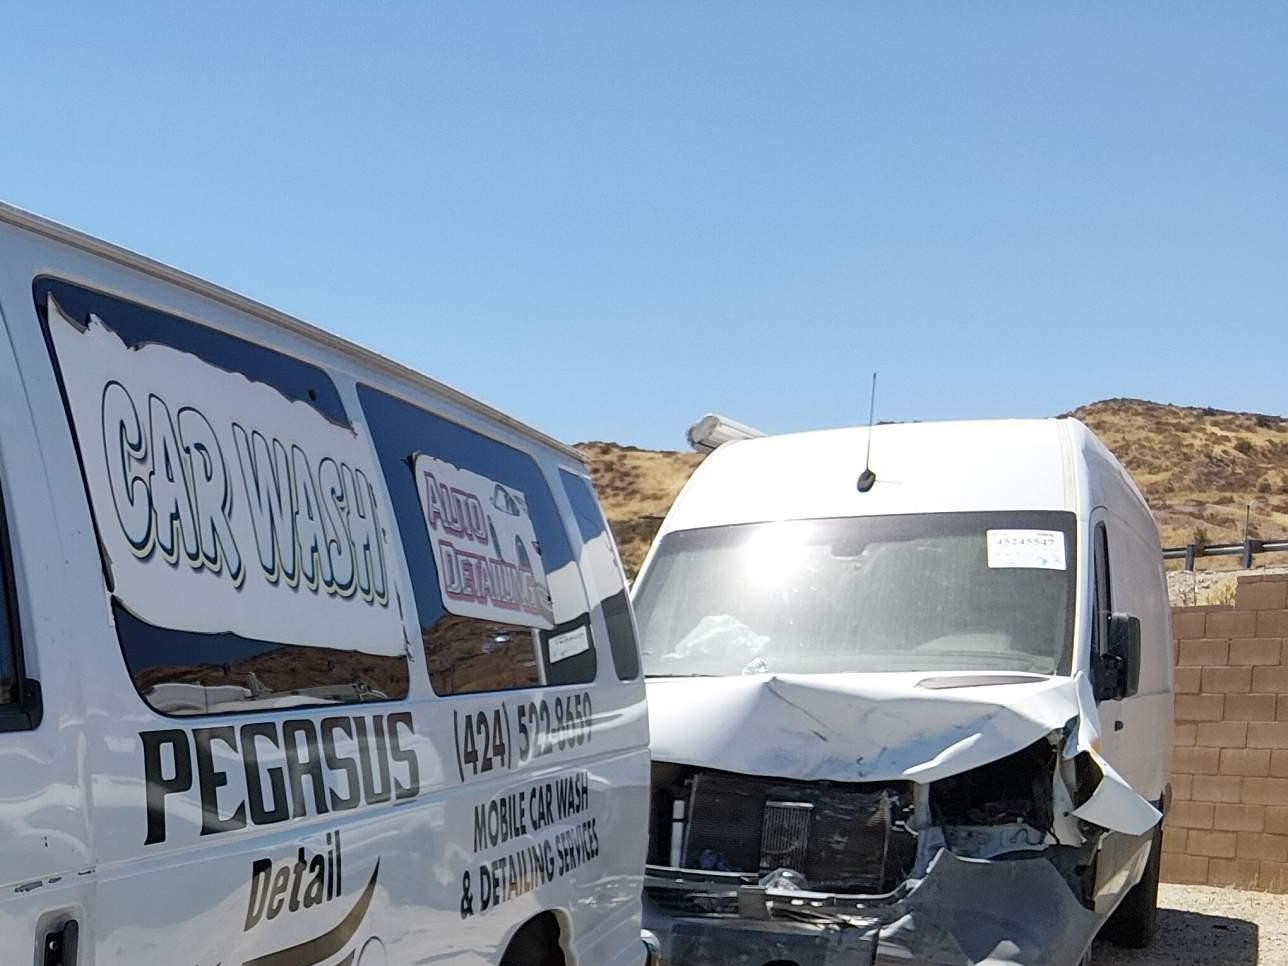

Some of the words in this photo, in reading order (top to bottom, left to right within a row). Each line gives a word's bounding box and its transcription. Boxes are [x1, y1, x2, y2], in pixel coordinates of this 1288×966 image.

[102, 380, 246, 589] CAR
[231, 422, 390, 609] WASH
[424, 471, 489, 546] AUTO
[139, 711, 420, 846] PEGASUS
[454, 701, 511, 783] (424)
[473, 791, 527, 853] MOBILE
[529, 783, 554, 831] CAR
[555, 772, 589, 819] WASH
[244, 829, 342, 932] Detail
[460, 869, 474, 920] &
[479, 838, 555, 913] DETAILING
[555, 817, 600, 877] SERVICES
